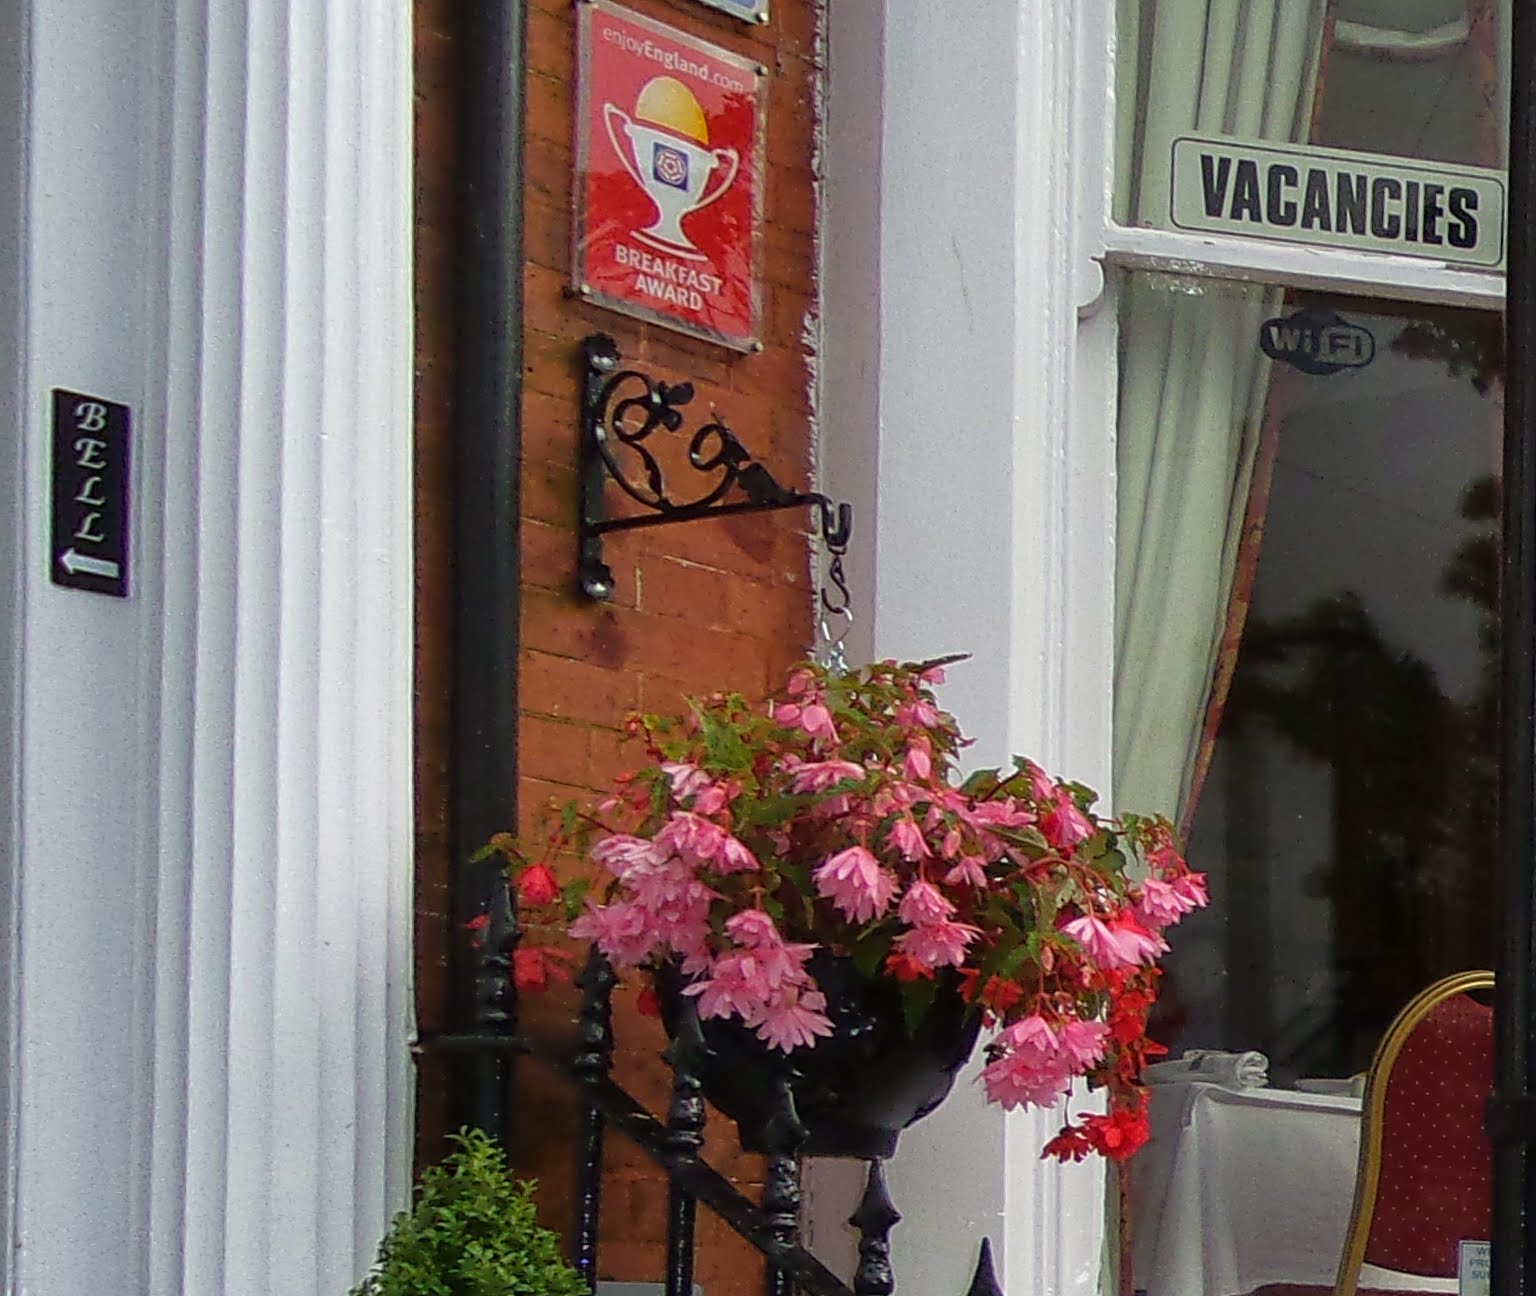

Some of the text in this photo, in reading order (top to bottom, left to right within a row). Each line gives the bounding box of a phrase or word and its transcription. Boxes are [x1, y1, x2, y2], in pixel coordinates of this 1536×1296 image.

[602, 25, 745, 92] enjoyEngland.com
[1200, 154, 1479, 249] VACANCIES
[615, 244, 723, 296] BREAKFAST
[634, 277, 703, 312] AWARD
[73, 402, 108, 542] BELL
